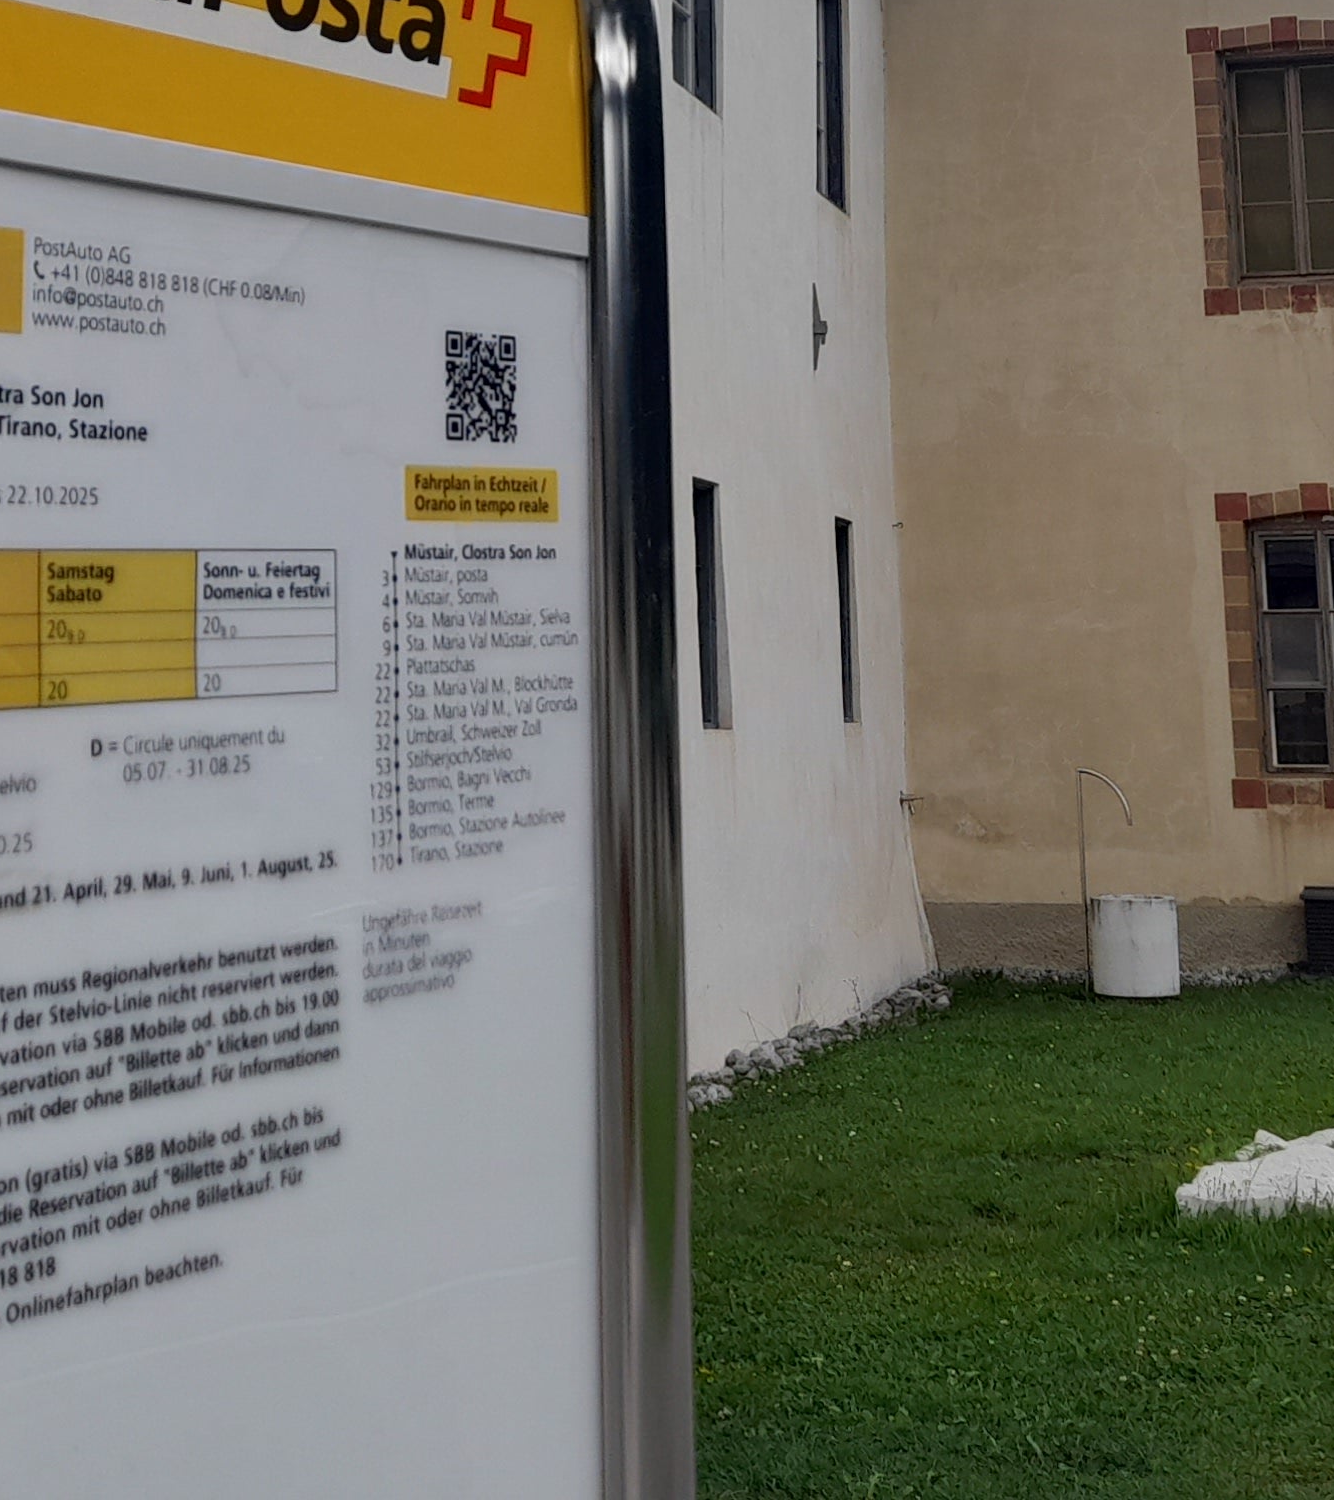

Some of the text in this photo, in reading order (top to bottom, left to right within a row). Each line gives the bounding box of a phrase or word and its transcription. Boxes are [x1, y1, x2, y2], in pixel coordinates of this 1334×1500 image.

[34, 236, 131, 265] PostAuto AG
[51, 263, 78, 282] +41
[139, 270, 167, 291] 818
[171, 274, 199, 294] 818
[203, 277, 237, 298] (CHF
[33, 283, 164, 313] info@postauto.ch
[32, 311, 166, 337] www.postauto.ch
[31, 385, 66, 407] Son
[73, 388, 103, 409] Jon
[69, 418, 148, 442] Stazione
[7, 485, 98, 507] 22.10.2025
[415, 473, 470, 496] Fahrplan
[474, 475, 486, 492] in
[489, 475, 538, 494] Echtzeit
[414, 494, 549, 517] Orario in tempo reale
[404, 544, 556, 561] Müstair, Clostra Son Jon
[47, 562, 115, 584] Samstag
[204, 560, 320, 581] Sonn- u. Feiertag
[47, 583, 103, 604] Sabato
[203, 581, 330, 601] Domenica e festivi
[6, 1274, 139, 1325] Onlinefahrplan
[145, 1253, 222, 1287] beachten.
